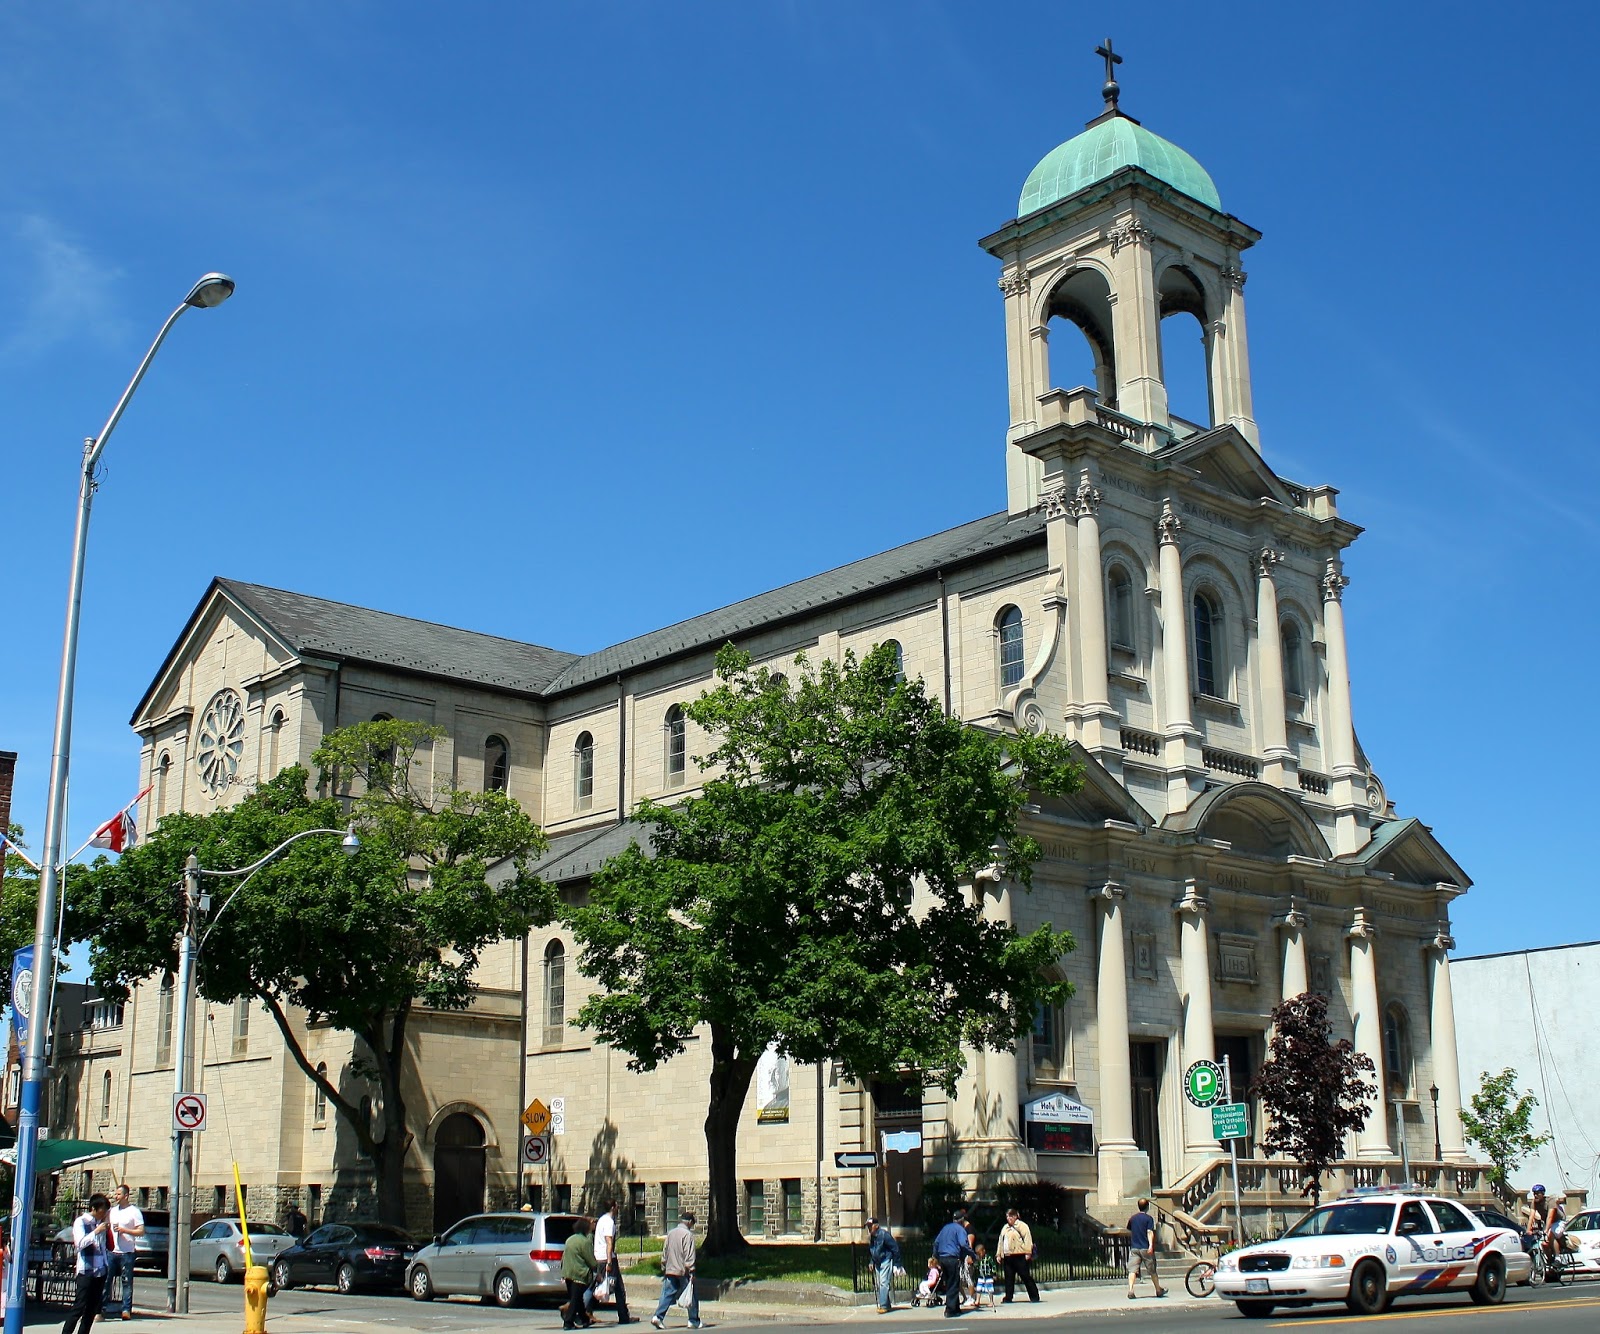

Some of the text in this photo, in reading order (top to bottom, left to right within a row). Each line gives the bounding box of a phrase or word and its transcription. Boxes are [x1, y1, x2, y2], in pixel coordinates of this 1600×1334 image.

[1101, 473, 1146, 496] ANCTVS
[1183, 502, 1233, 528] SANCTVS
[1039, 841, 1081, 861] OMINE
[1126, 856, 1156, 873] IESV
[1216, 872, 1249, 889] OMNE
[1228, 958, 1245, 970] IHS
[1185, 1061, 1221, 1084] MUNICIPAL
[1195, 1072, 1211, 1092] P
[1185, 1086, 1222, 1107] PARKING
[1041, 1101, 1081, 1112] Holy Name
[526, 1112, 546, 1124] SLOW
[1410, 1246, 1475, 1264] POLICE
